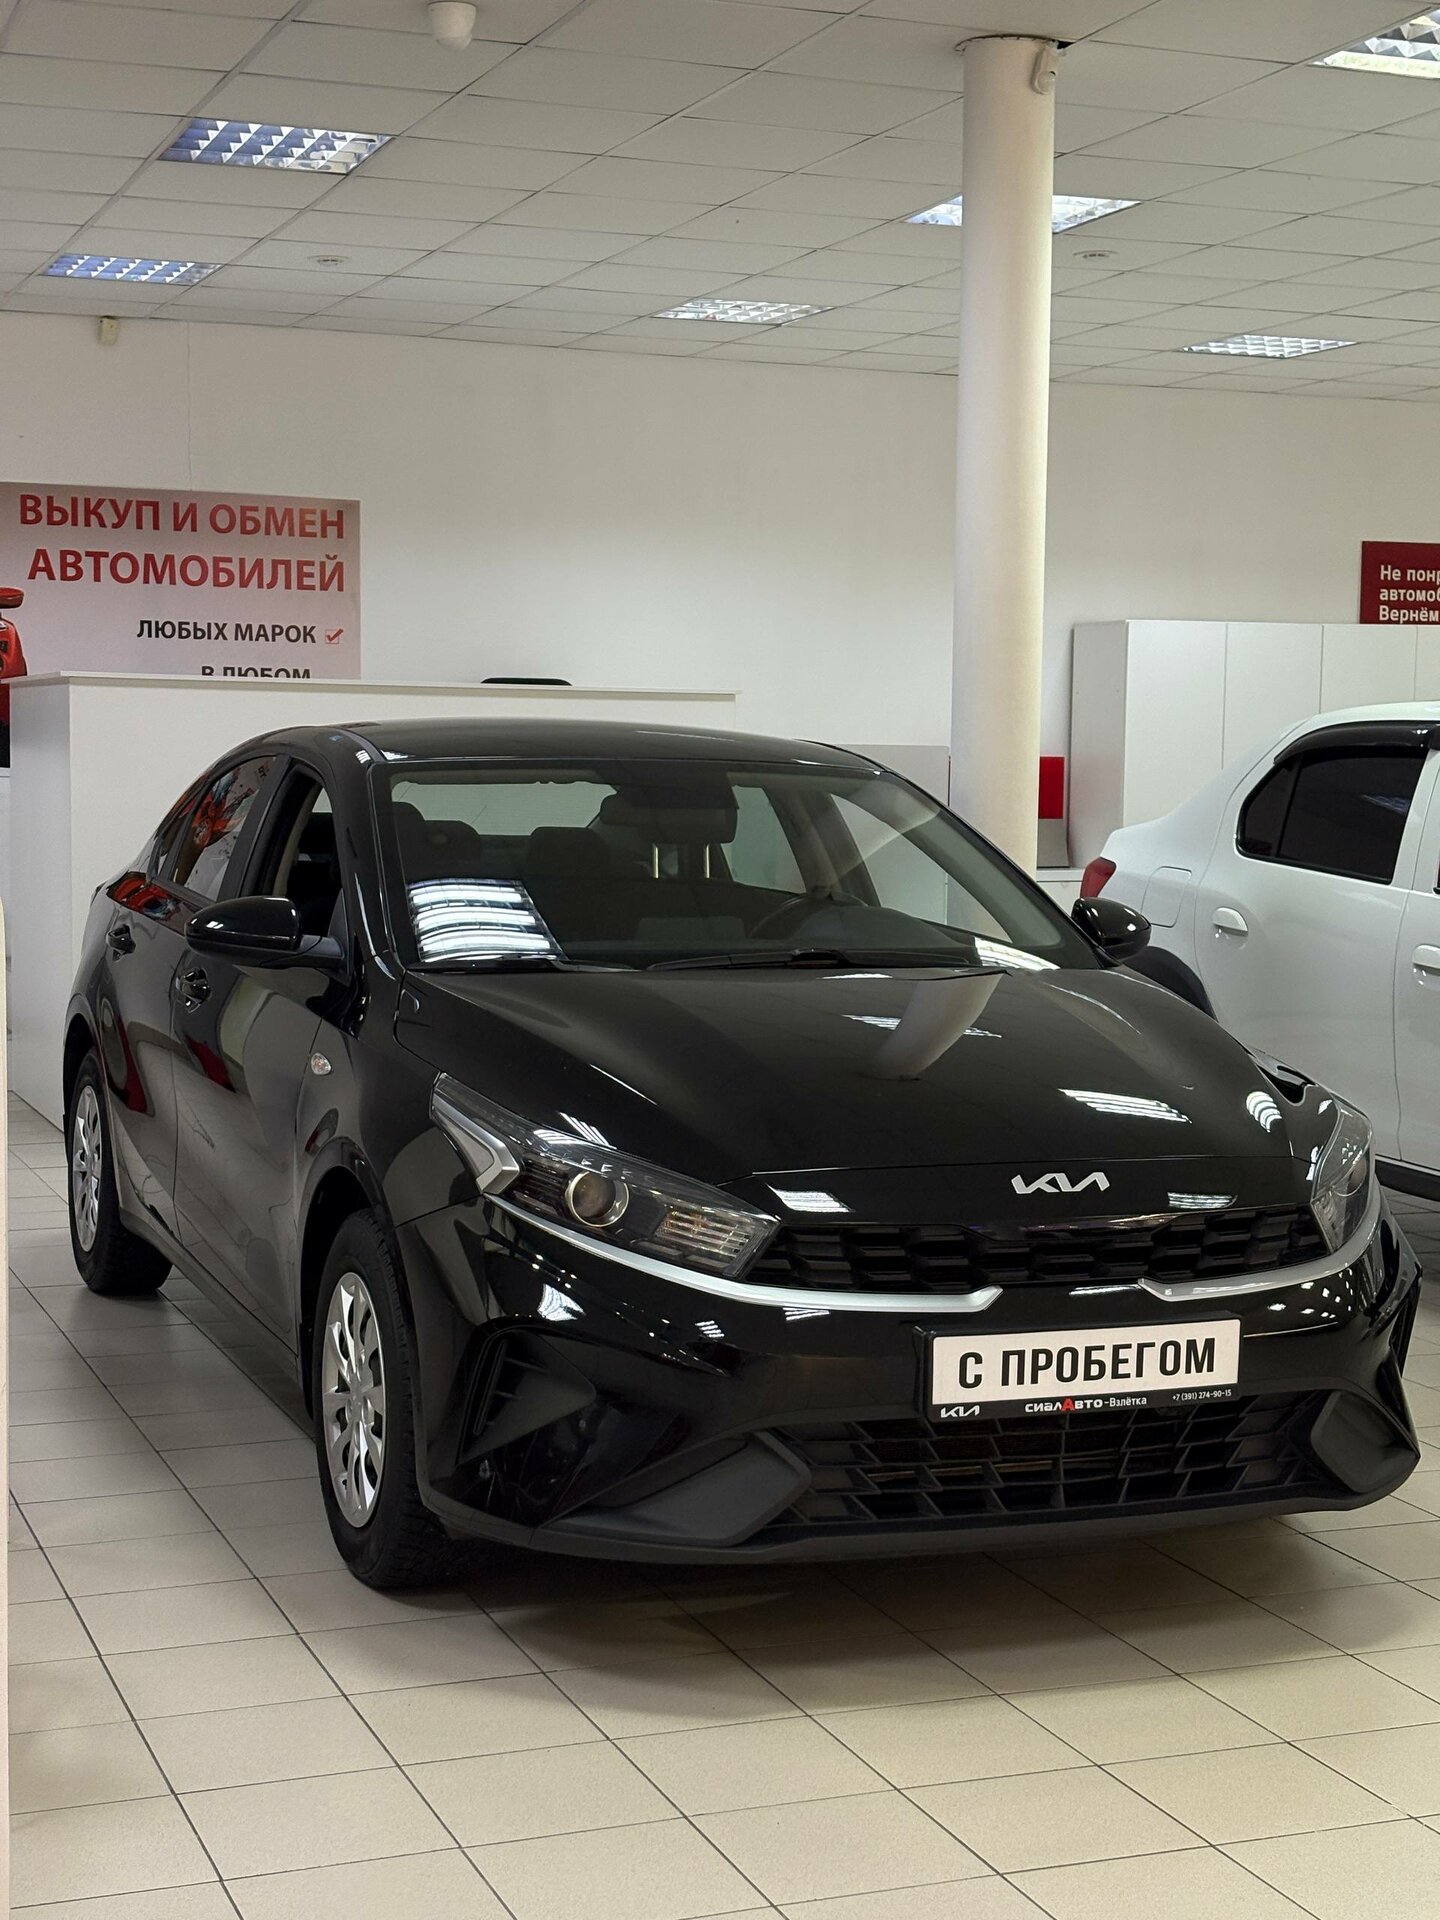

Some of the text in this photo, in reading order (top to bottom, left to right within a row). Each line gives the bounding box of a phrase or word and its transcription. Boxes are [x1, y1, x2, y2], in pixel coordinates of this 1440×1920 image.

[19, 494, 345, 539] ВЫКУП И ОБМЕН
[27, 548, 345, 592] АВТОМОБИЛЕЙ
[1380, 564, 1401, 581] Не
[1379, 604, 1439, 624] Вернём
[136, 620, 317, 644] ЛЮБЫХ МАРОК
[1011, 1171, 1110, 1194] KIA
[958, 1337, 1216, 1389] С ПРОБЕГОМ
[1172, 1389, 1232, 1401] +7 (391) 274-90-15
[940, 1405, 980, 1418] KIA
